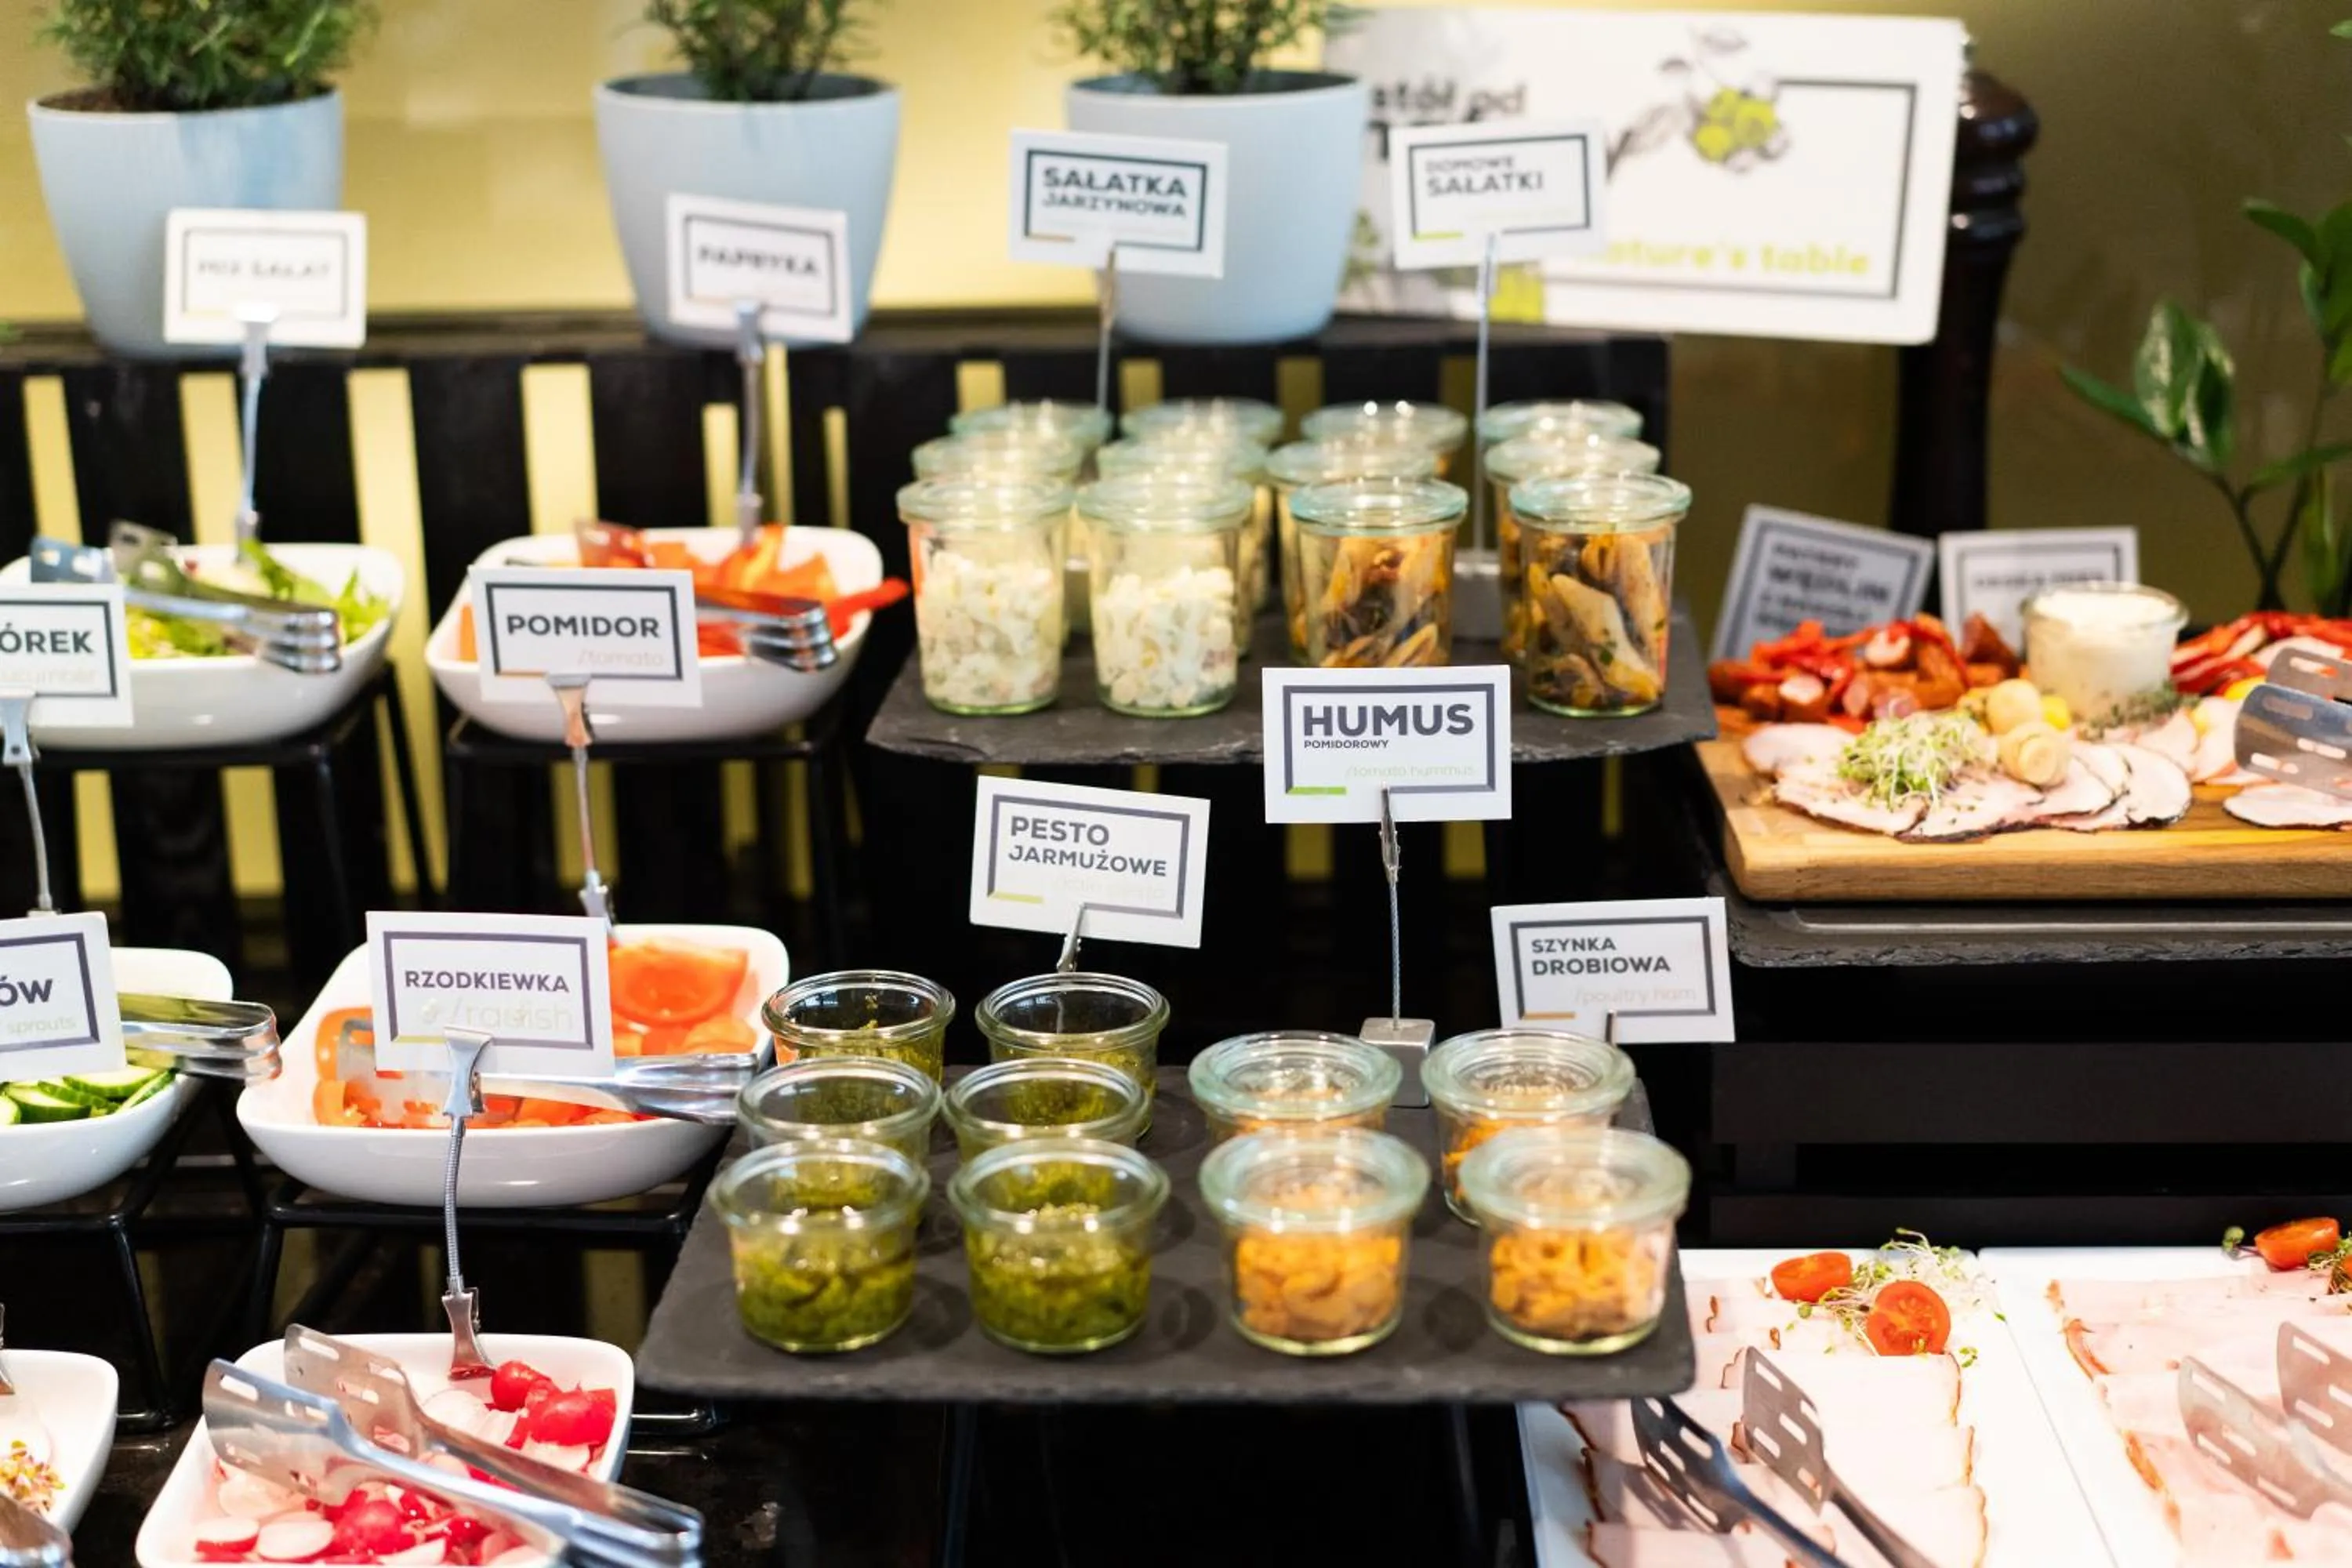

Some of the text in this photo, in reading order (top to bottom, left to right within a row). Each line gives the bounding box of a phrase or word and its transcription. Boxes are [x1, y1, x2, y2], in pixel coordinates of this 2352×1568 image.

[1043, 167, 1187, 198] SAŁATKA
[1427, 172, 1544, 197] SAŁATKI
[1042, 193, 1187, 218] JARZYNOWA
[0, 622, 93, 653] ÓREK
[506, 615, 661, 638] POMIDOR
[1303, 703, 1475, 736] HUMUS
[1304, 739, 1389, 750] POMIDOROWY
[1410, 764, 1475, 777] hummus
[1010, 815, 1110, 846] PESTO
[1008, 844, 1167, 877] JARMUŻOWE
[1531, 937, 1617, 953] SZYNKA
[1532, 956, 1671, 975] DROBIOWA
[405, 970, 570, 993] RZODKIEWKA
